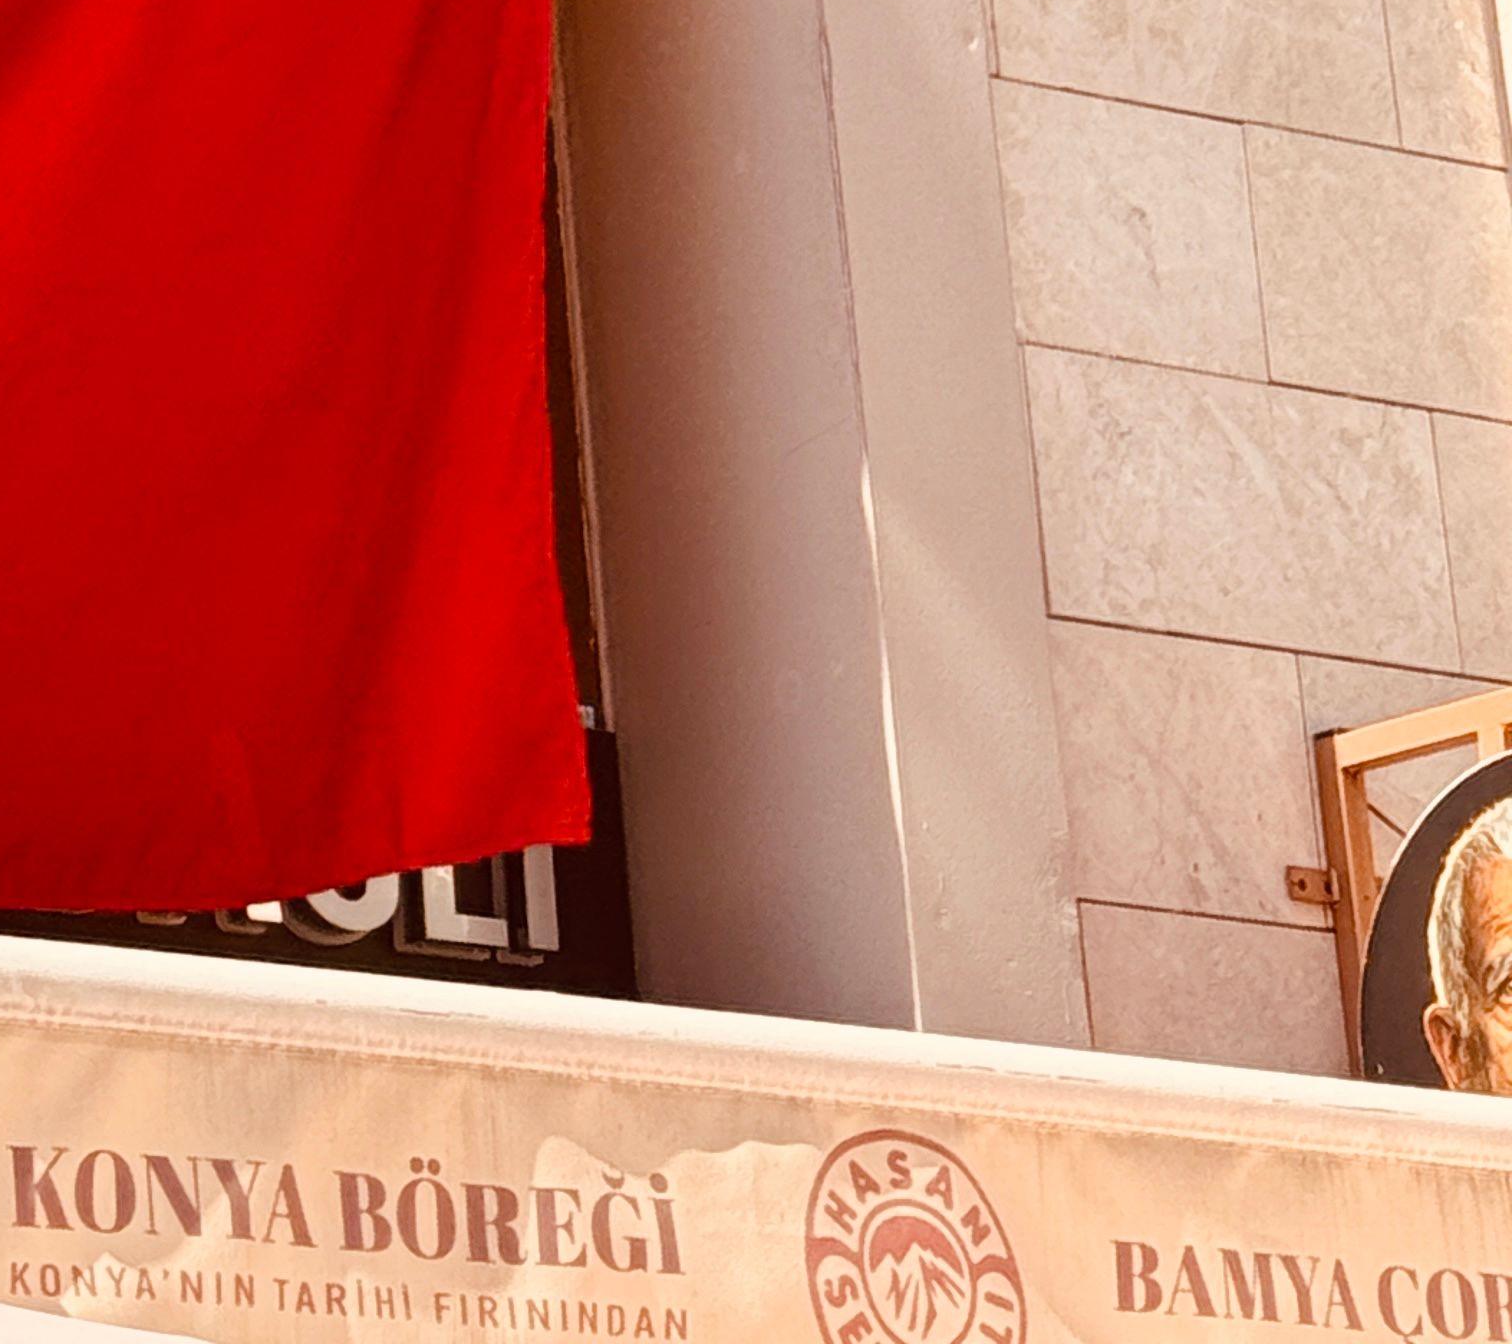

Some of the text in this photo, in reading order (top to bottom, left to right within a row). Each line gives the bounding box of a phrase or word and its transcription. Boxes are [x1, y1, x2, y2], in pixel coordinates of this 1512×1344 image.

[9, 1143, 686, 1275] KONYA BÖREĞİ
[823, 1148, 992, 1248] HASAN
[9, 1261, 687, 1341] KONYA'NIN TARİHİ FIRININDAN
[1109, 1239, 1365, 1331] BAMYA
